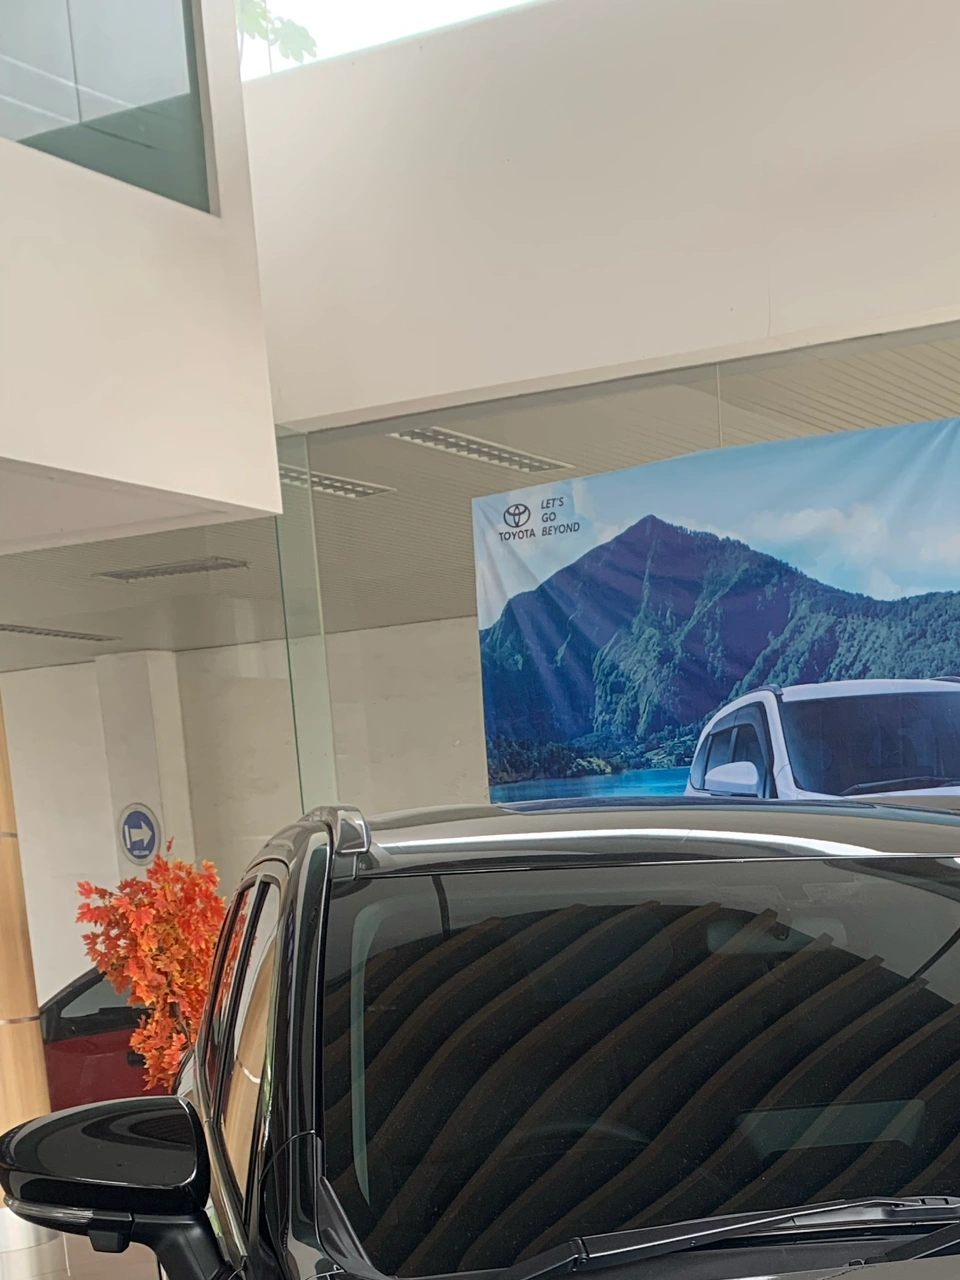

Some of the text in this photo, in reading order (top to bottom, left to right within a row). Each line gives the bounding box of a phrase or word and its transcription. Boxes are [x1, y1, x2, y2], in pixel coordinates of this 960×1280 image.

[541, 497, 564, 509] LET'S
[541, 512, 557, 523] GO
[498, 528, 536, 542] TOYOTA
[541, 522, 580, 537] BEYOND
